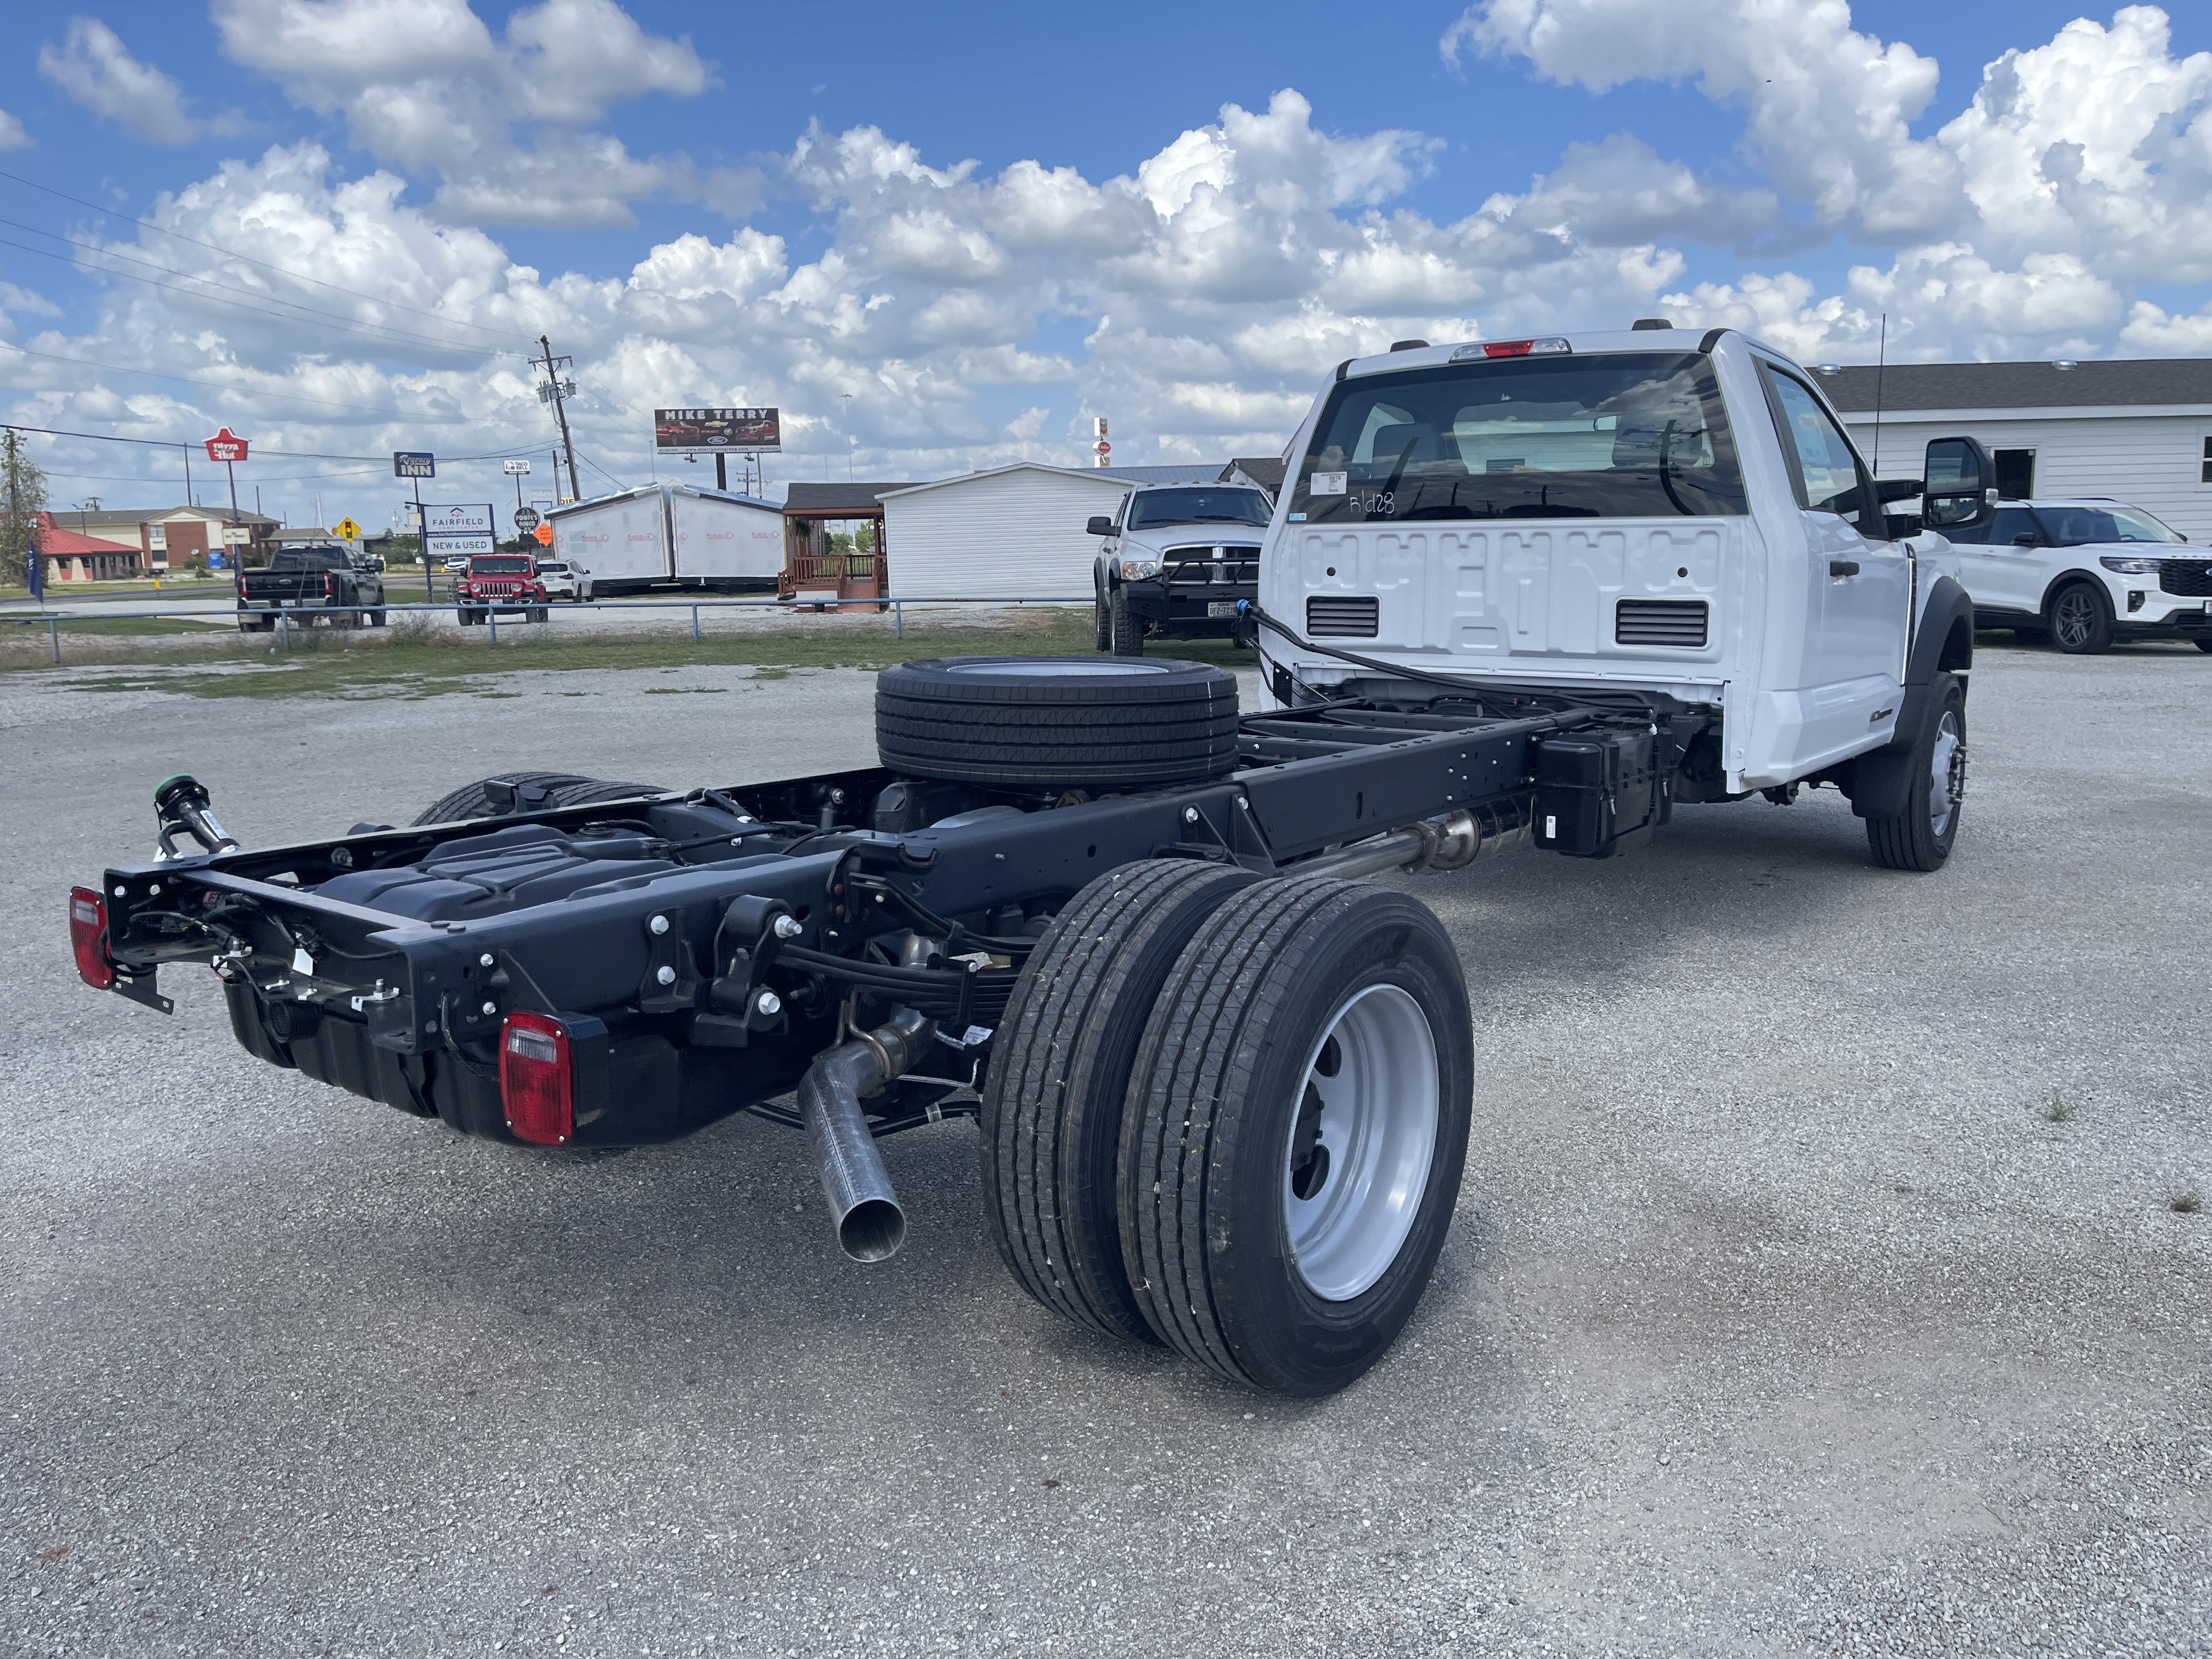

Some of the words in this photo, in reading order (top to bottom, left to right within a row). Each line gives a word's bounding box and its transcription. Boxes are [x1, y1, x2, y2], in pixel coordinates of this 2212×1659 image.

[665, 410, 706, 420] MIKE
[714, 409, 768, 419] TERRY
[215, 450, 235, 459] Hut
[399, 454, 431, 465] Regency
[401, 465, 432, 476] INN
[462, 541, 487, 549] USED
